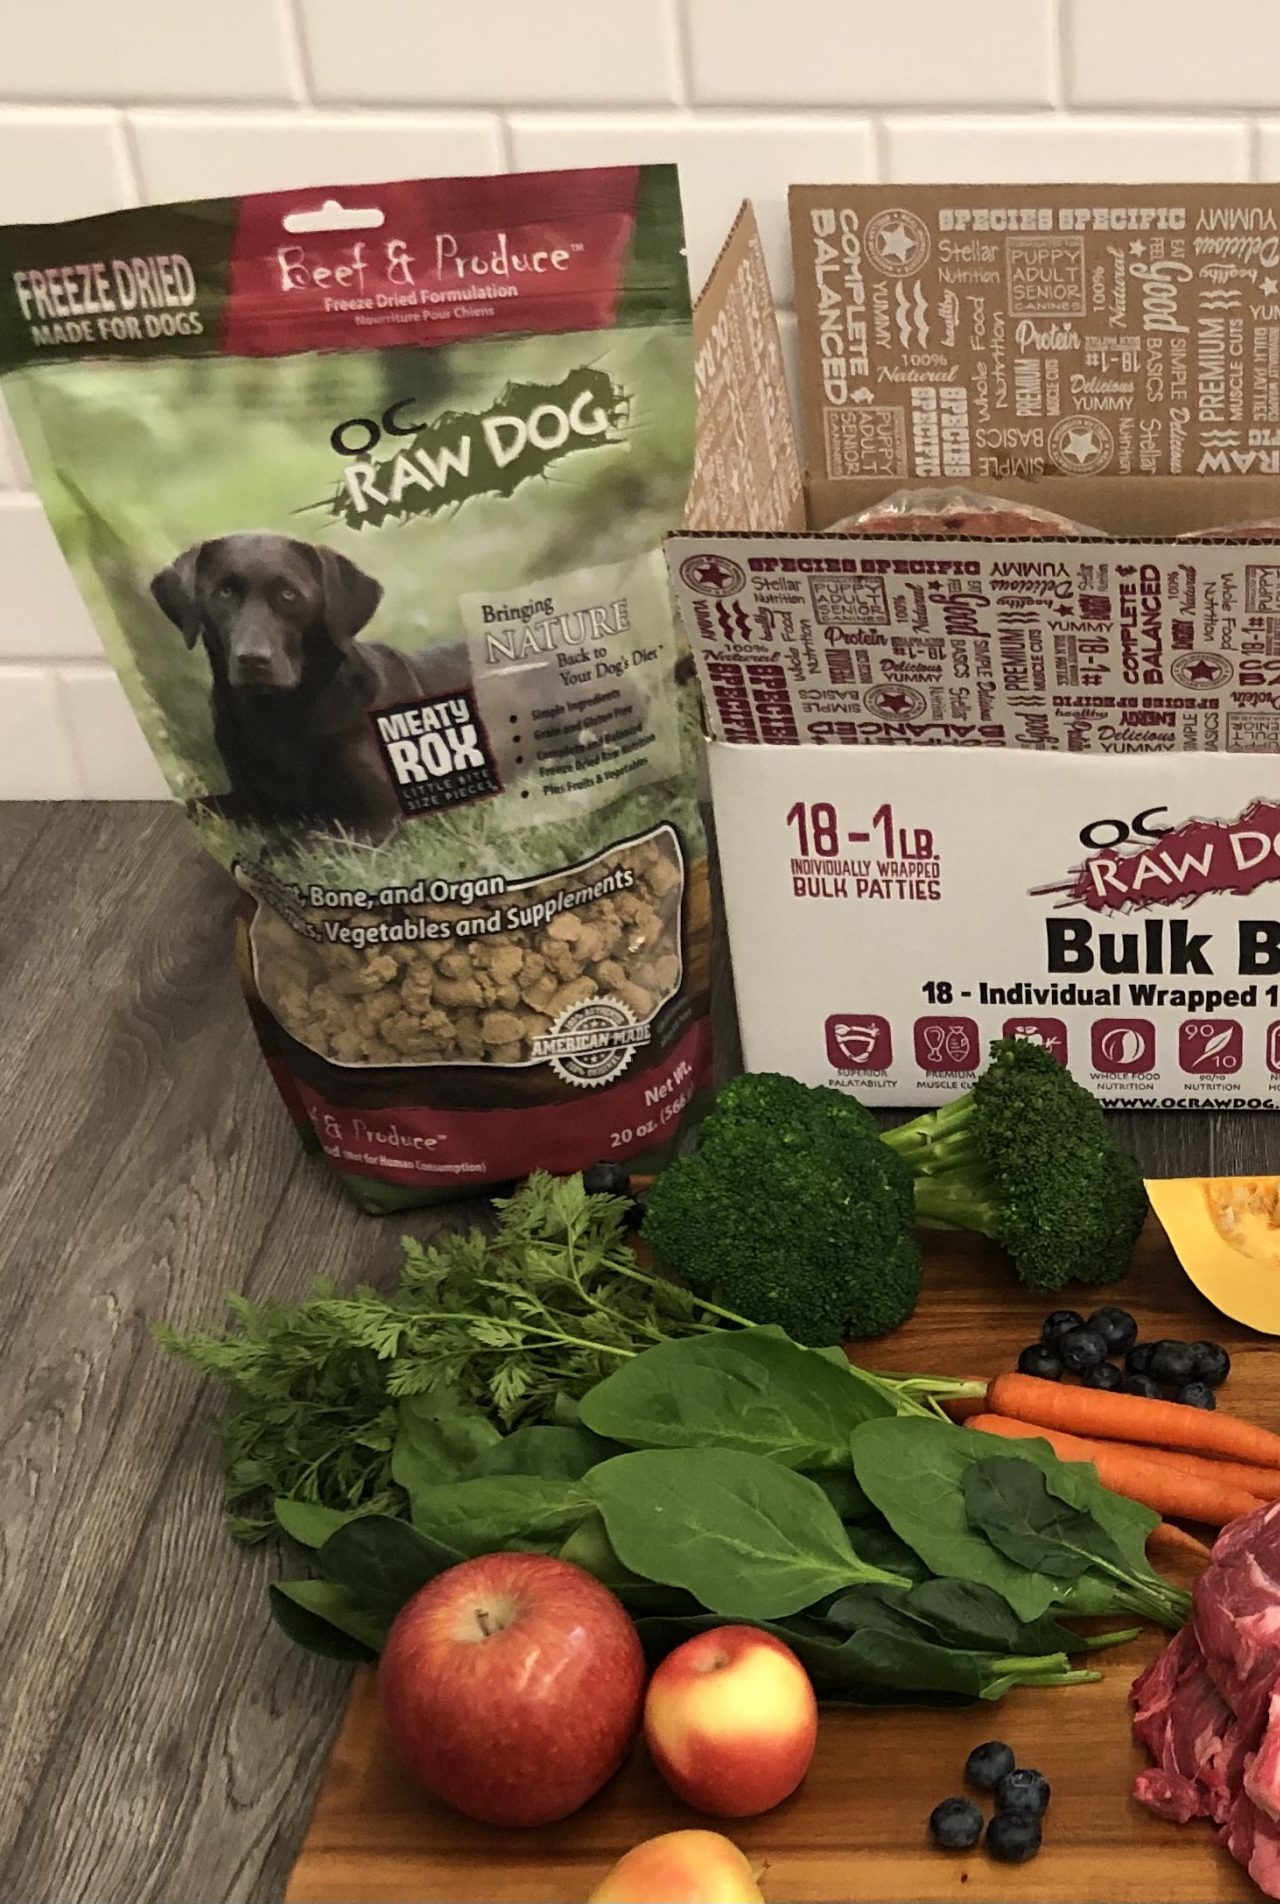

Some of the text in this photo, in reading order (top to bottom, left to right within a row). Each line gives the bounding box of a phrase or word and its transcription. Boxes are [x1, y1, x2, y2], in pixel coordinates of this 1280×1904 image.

[939, 208, 1186, 231] SPECIES SPECIFIC
[278, 242, 368, 291] Beef
[387, 240, 415, 286] &
[938, 239, 999, 263] Stellar
[1012, 250, 1081, 265] PUPPY
[13, 254, 196, 321] FREEZE DRIED
[938, 268, 1000, 284] Nutrition
[1013, 267, 1080, 282] ADULT
[325, 283, 518, 313] Freeze Dried Formulation
[811, 208, 848, 405] BALANCED
[840, 209, 869, 376] COMPLETE
[1014, 284, 1081, 300] SENIOR
[31, 311, 203, 347] MADE FOR DOGS
[355, 304, 495, 327] Nourriture Pour Chiens
[1015, 320, 1081, 354] Protein
[329, 397, 428, 456] OC
[343, 392, 610, 513] RAW DOG
[481, 597, 554, 625] Bringing
[485, 598, 632, 665] NATURE
[556, 647, 608, 668] Back to
[559, 669, 591, 687] Your
[595, 655, 631, 677] Dog's
[377, 698, 470, 744] MEATY
[1098, 725, 1176, 742] Delicious
[386, 724, 485, 786] ROX
[1078, 806, 1174, 850] OC
[791, 858, 941, 879] INDIVIDUALLY WRAPPED
[1088, 842, 1214, 898] RAW
[311, 887, 373, 909] Bone,
[380, 884, 424, 906] and
[429, 875, 506, 906] Organ
[793, 877, 941, 900] BULK PATTIES
[326, 868, 635, 948] Vegetables and Supplements
[1045, 917, 1214, 975] Bulk
[922, 981, 954, 1005] 18
[979, 982, 1121, 1006] Individual
[1128, 983, 1257, 1013] Wrapped
[1264, 985, 1279, 1006] 1
[531, 1024, 651, 1057] AMERICAN MADE
[1185, 1024, 1215, 1040] 90
[925, 1071, 977, 1080] PREMIUM
[1212, 1055, 1237, 1069] 10
[829, 1079, 898, 1089] PALATABILITY
[916, 1080, 958, 1090] MUSCLE
[1090, 1072, 1161, 1082] WHOLE FOOD
[1097, 1082, 1155, 1092] NUTRITION
[1184, 1083, 1241, 1092] NUTRITION
[644, 1077, 674, 1107] Net
[610, 1128, 633, 1148] 20
